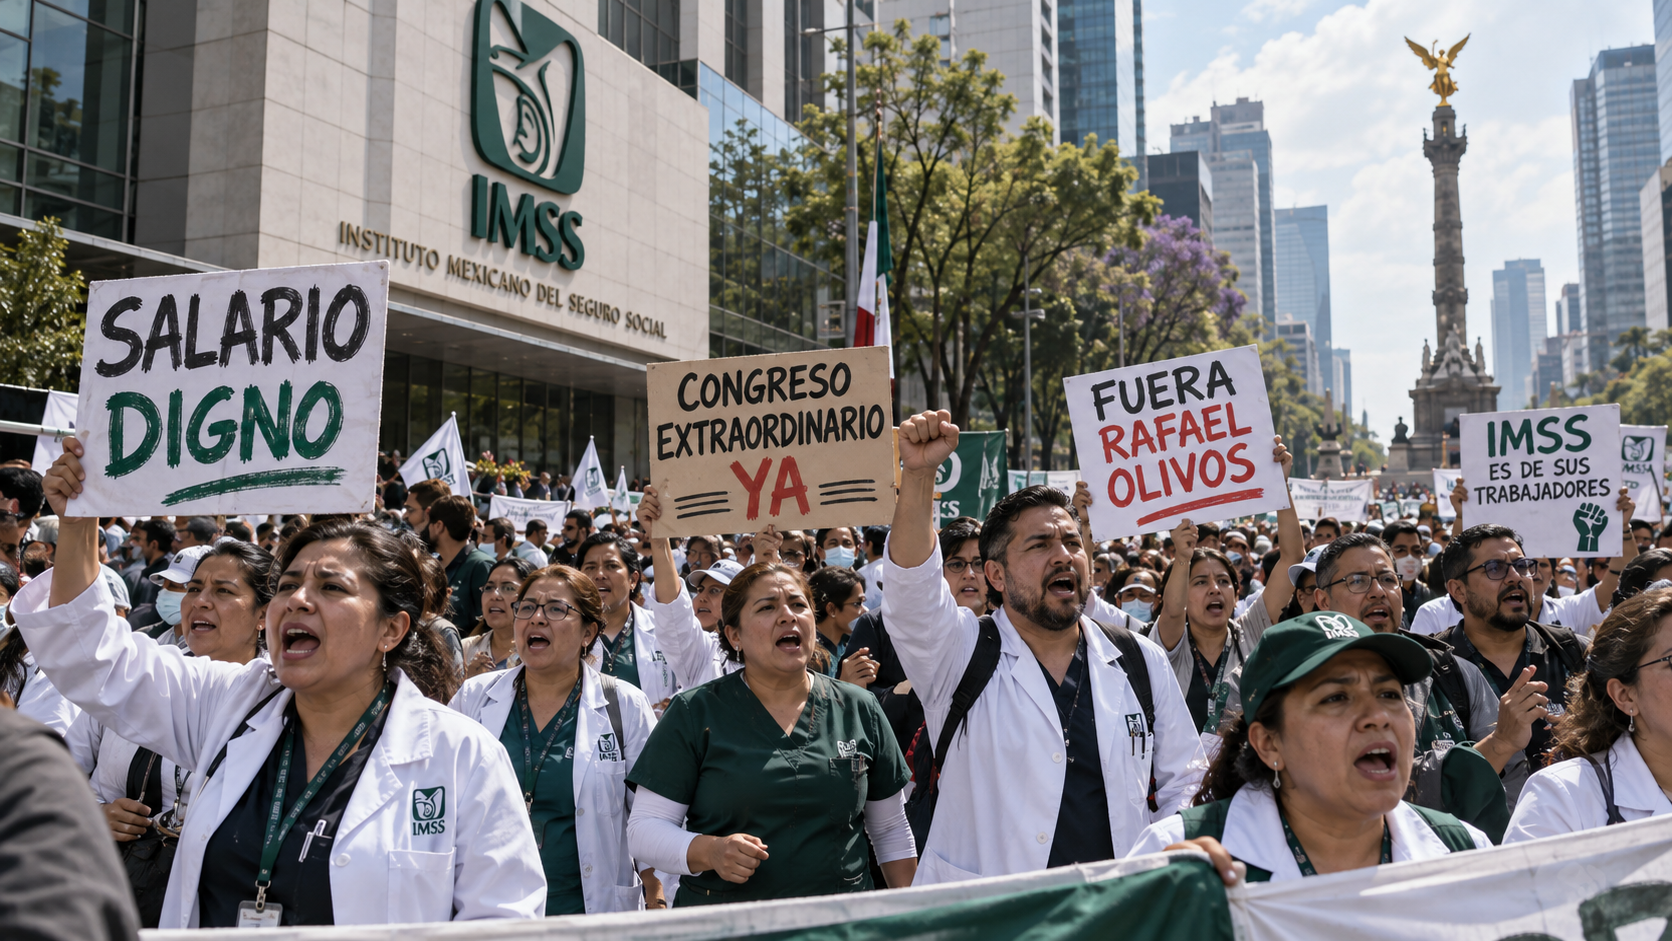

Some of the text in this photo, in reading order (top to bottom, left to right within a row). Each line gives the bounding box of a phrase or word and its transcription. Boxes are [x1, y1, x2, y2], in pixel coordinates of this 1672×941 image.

[470, 174, 585, 271] IMSS
[340, 220, 668, 340] INSTITUTO MEXICANO DEL SEGURO SOCIAL
[95, 283, 371, 378] SALARIO
[676, 361, 853, 413] CONGRESO
[1090, 360, 1238, 422] FUERA
[103, 378, 346, 480] DIGNO
[656, 403, 886, 462] EXTRAORDINARIO
[1098, 402, 1253, 464] RAFAEL
[1486, 413, 1594, 459] IMSS
[730, 455, 811, 521] YA
[1107, 442, 1257, 508] OLIVOS
[1473, 478, 1611, 506] TRABAJADORES
[1489, 457, 1591, 482] ES DE SUS
[412, 819, 446, 836] IMSS
